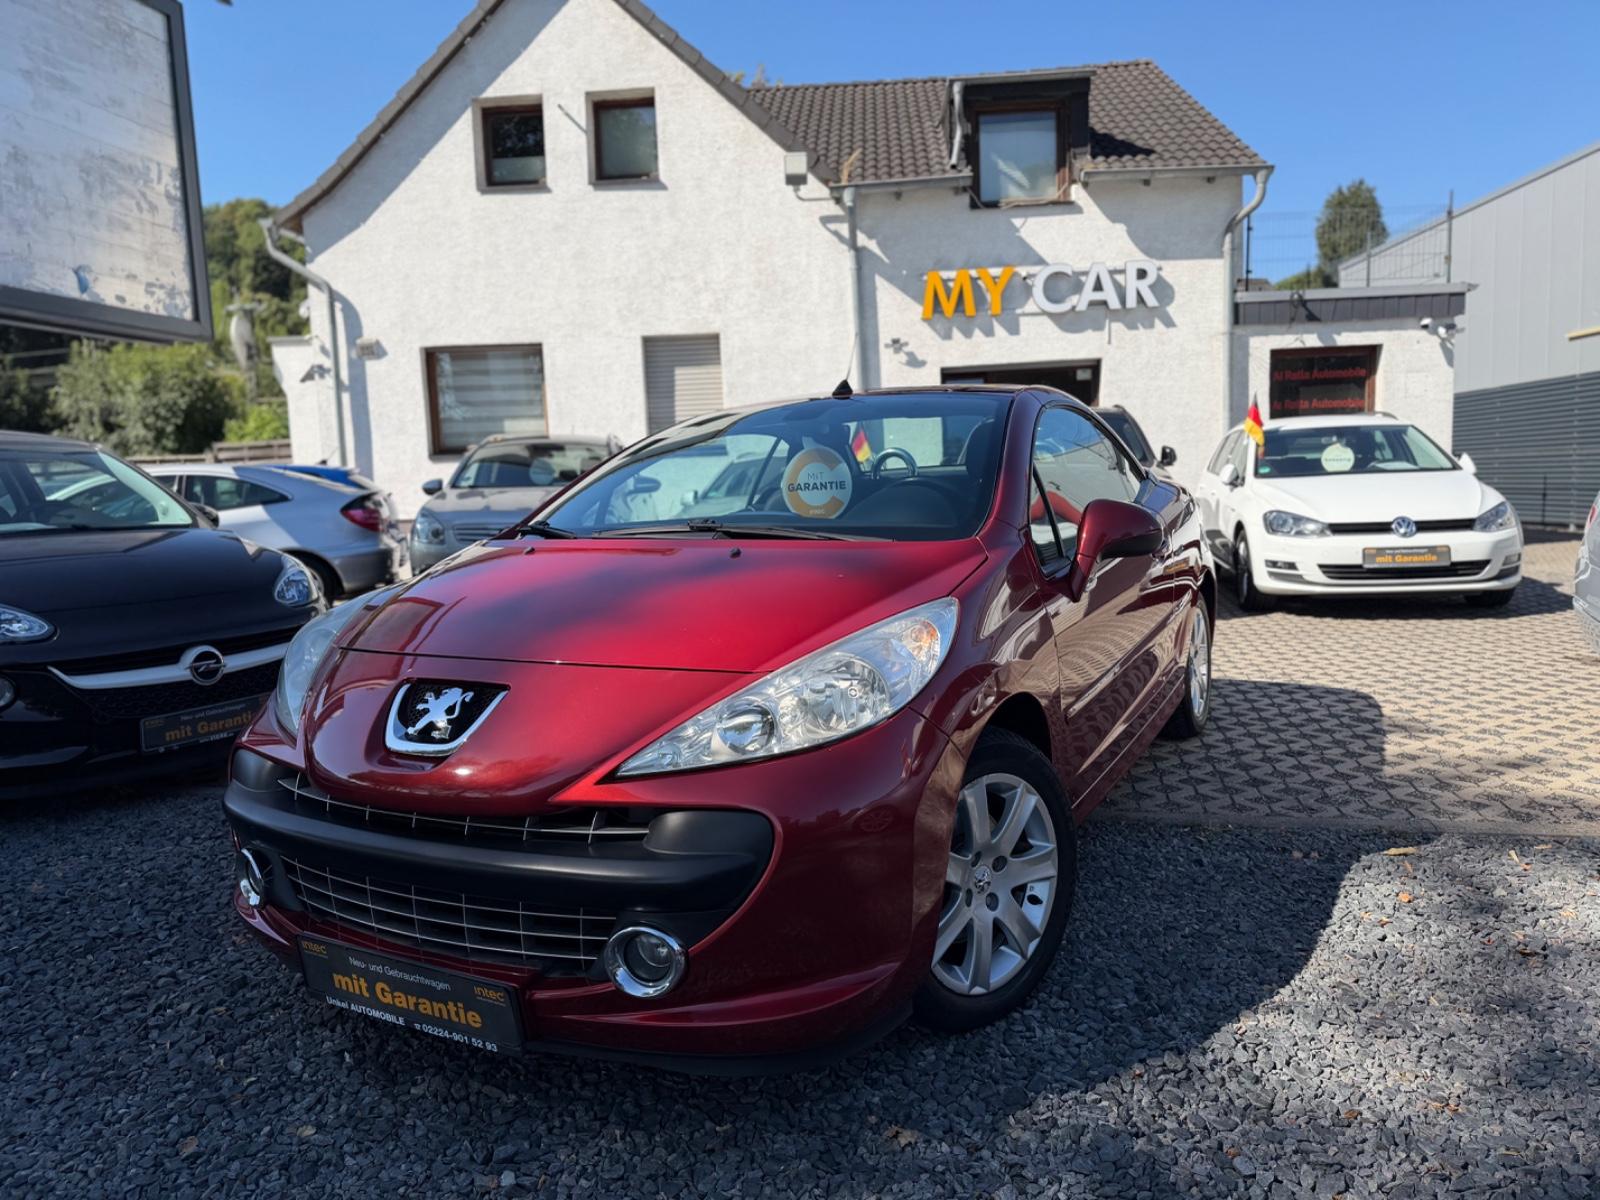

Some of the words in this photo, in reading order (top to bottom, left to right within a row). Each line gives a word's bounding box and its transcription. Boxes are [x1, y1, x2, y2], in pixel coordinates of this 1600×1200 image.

[922, 266, 1015, 320] MY
[1032, 260, 1160, 313] CAR
[788, 480, 847, 492] GARANTIE
[165, 725, 193, 742] mit
[197, 711, 253, 734] Garanti
[384, 966, 451, 991] Gebrauchtwagen
[332, 972, 370, 998] mit
[375, 981, 483, 1028] Garantie
[350, 1003, 405, 1026] AUTOMOBILE
